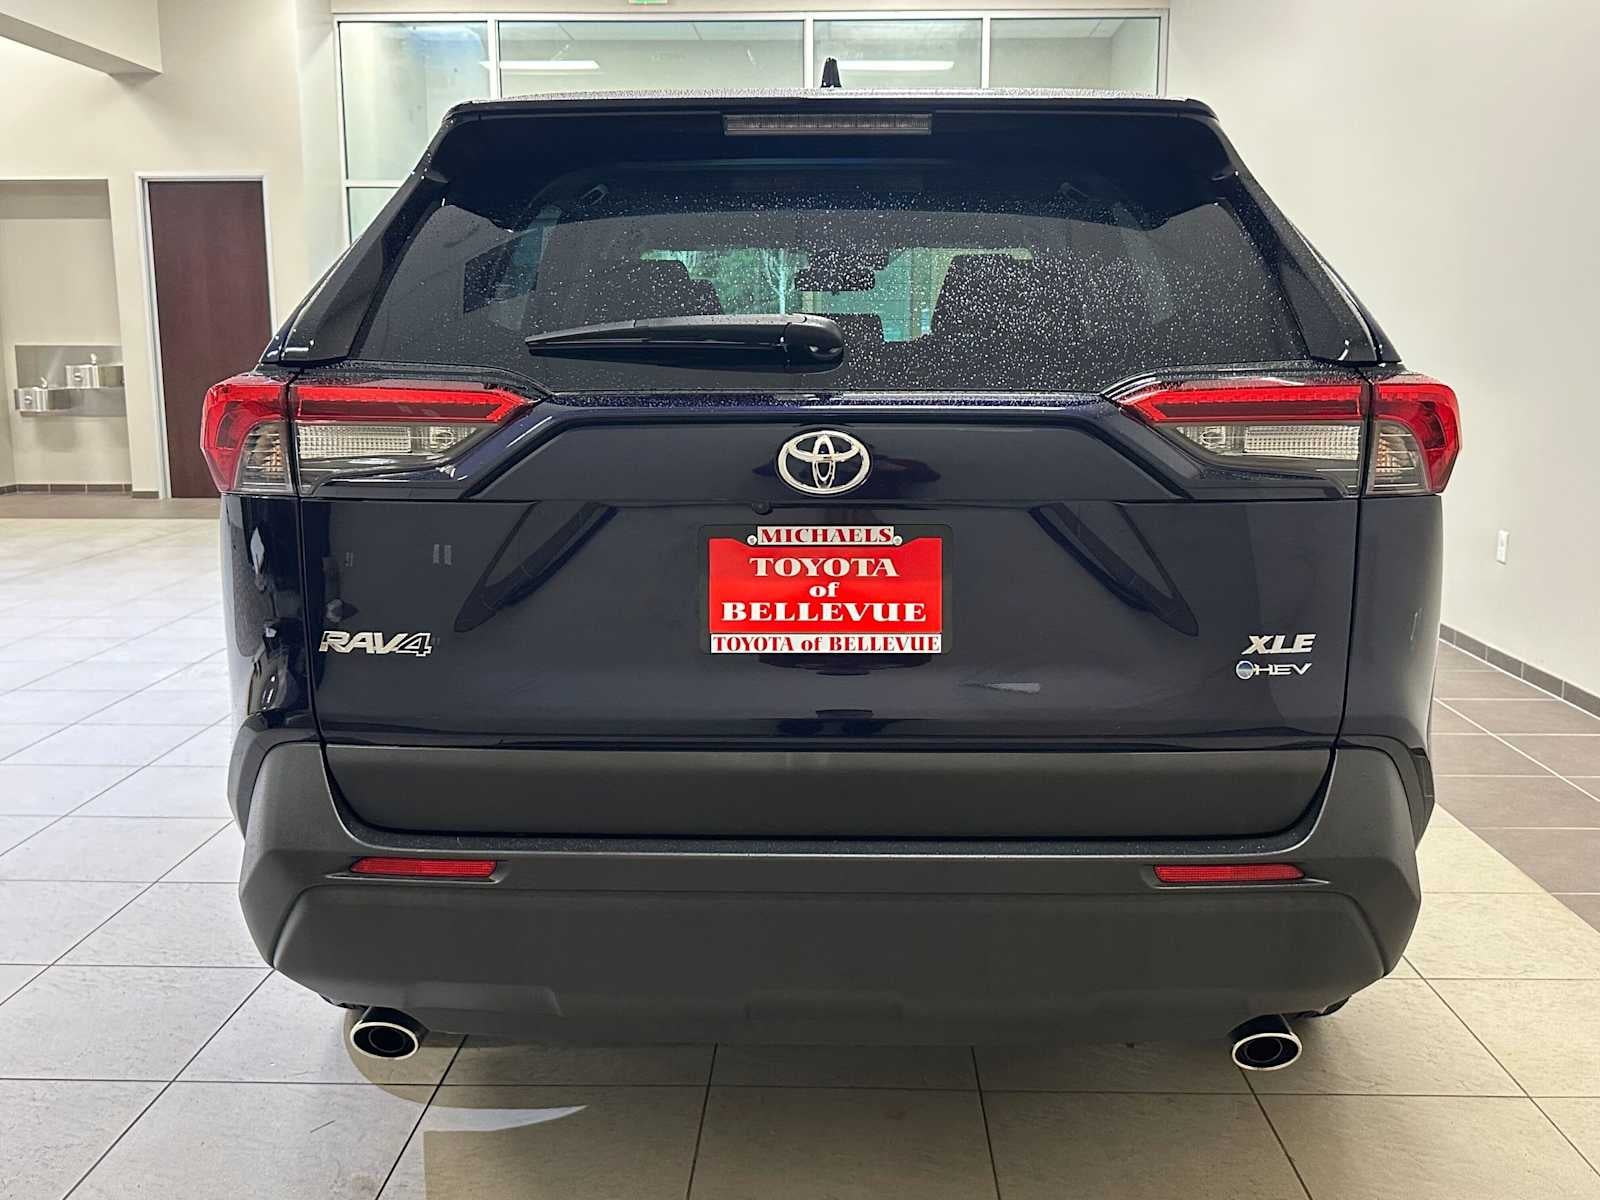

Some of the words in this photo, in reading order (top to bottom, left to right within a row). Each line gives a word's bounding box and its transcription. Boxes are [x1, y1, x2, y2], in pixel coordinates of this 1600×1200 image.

[760, 528, 892, 543] MICHAELS
[749, 557, 900, 577] TOYOTA
[808, 582, 840, 598] of
[721, 602, 927, 622] BELLEVUE
[318, 630, 432, 657] RAV4
[713, 636, 793, 651] TOYOTA
[801, 636, 824, 651] of
[829, 636, 941, 651] BELLEVUE
[1241, 633, 1317, 655] XLE
[1253, 662, 1313, 676] HEV
